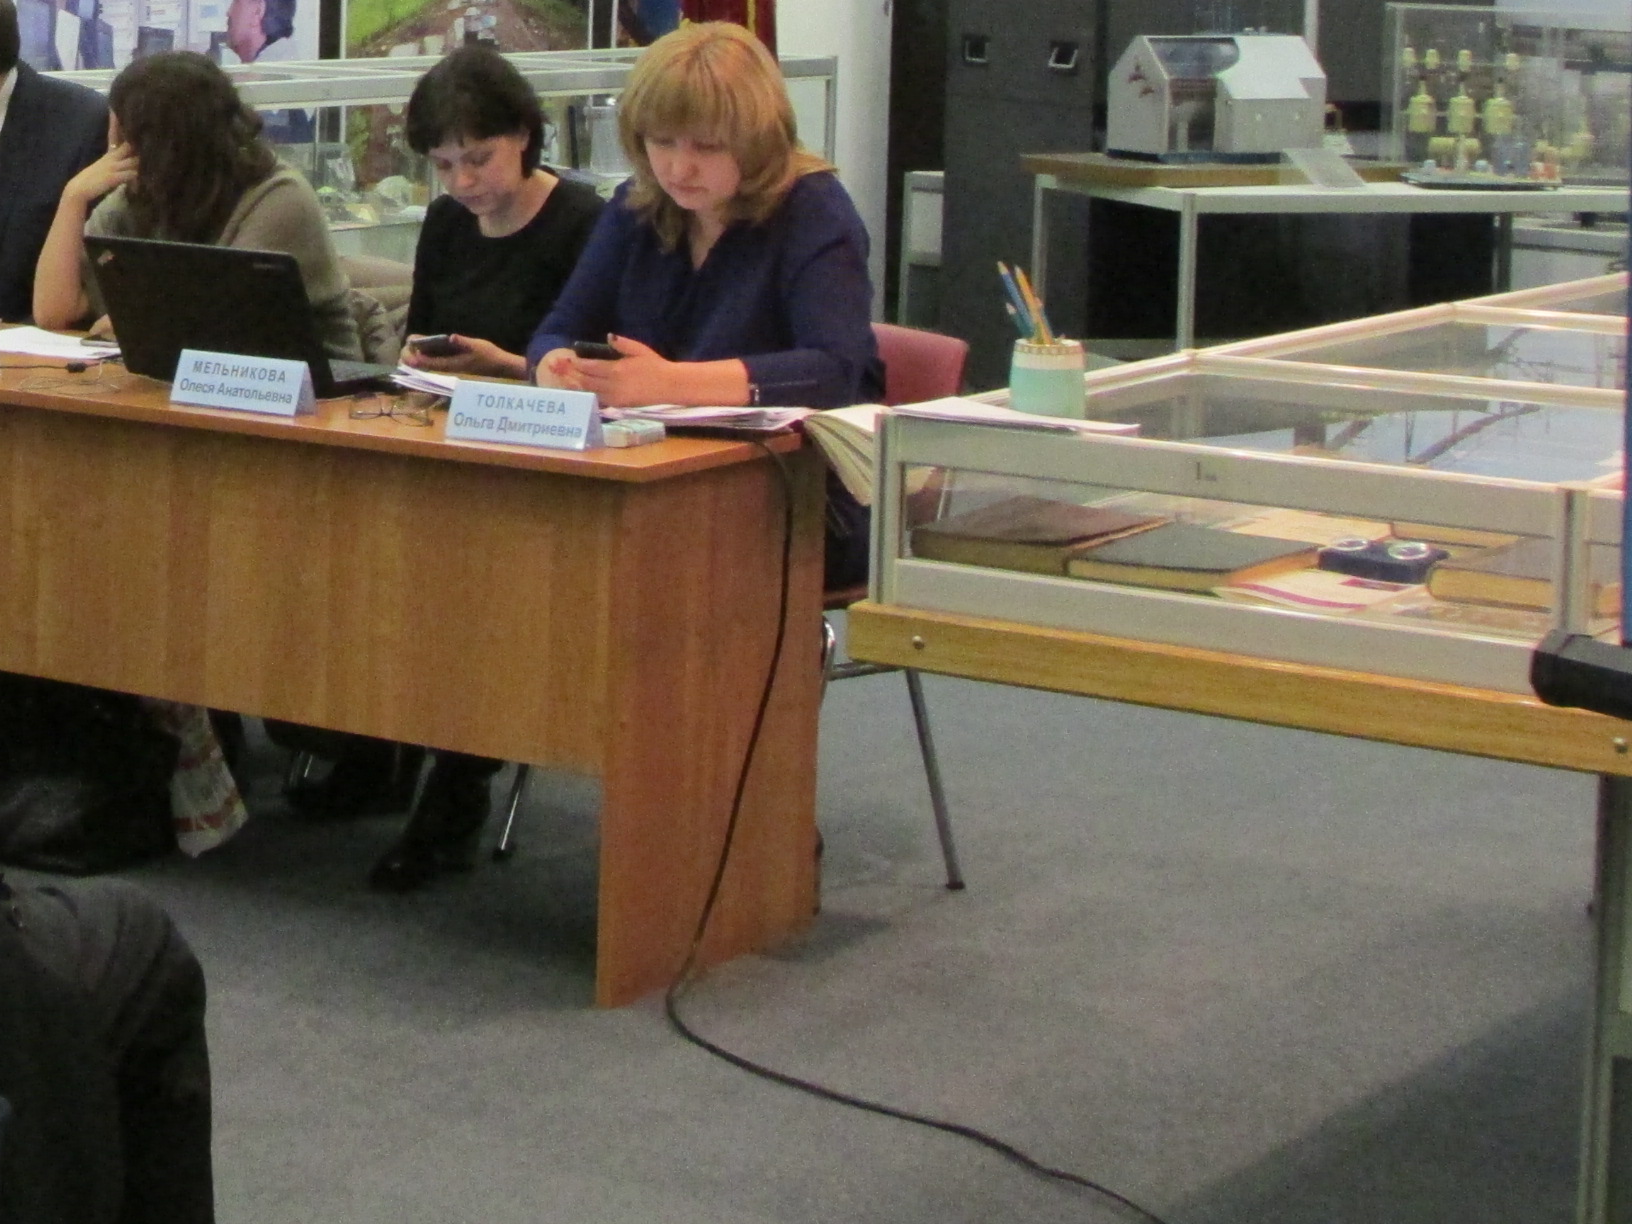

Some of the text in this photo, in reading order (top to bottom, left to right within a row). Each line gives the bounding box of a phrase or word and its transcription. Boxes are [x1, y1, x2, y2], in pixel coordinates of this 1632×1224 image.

[193, 361, 286, 383] МЕЛЬНИКОВА
[180, 378, 292, 404] Олеся Анатольевна
[477, 394, 566, 415] ТОЛКАЧЕВА
[453, 412, 583, 439] Ольга Дмитриевна
